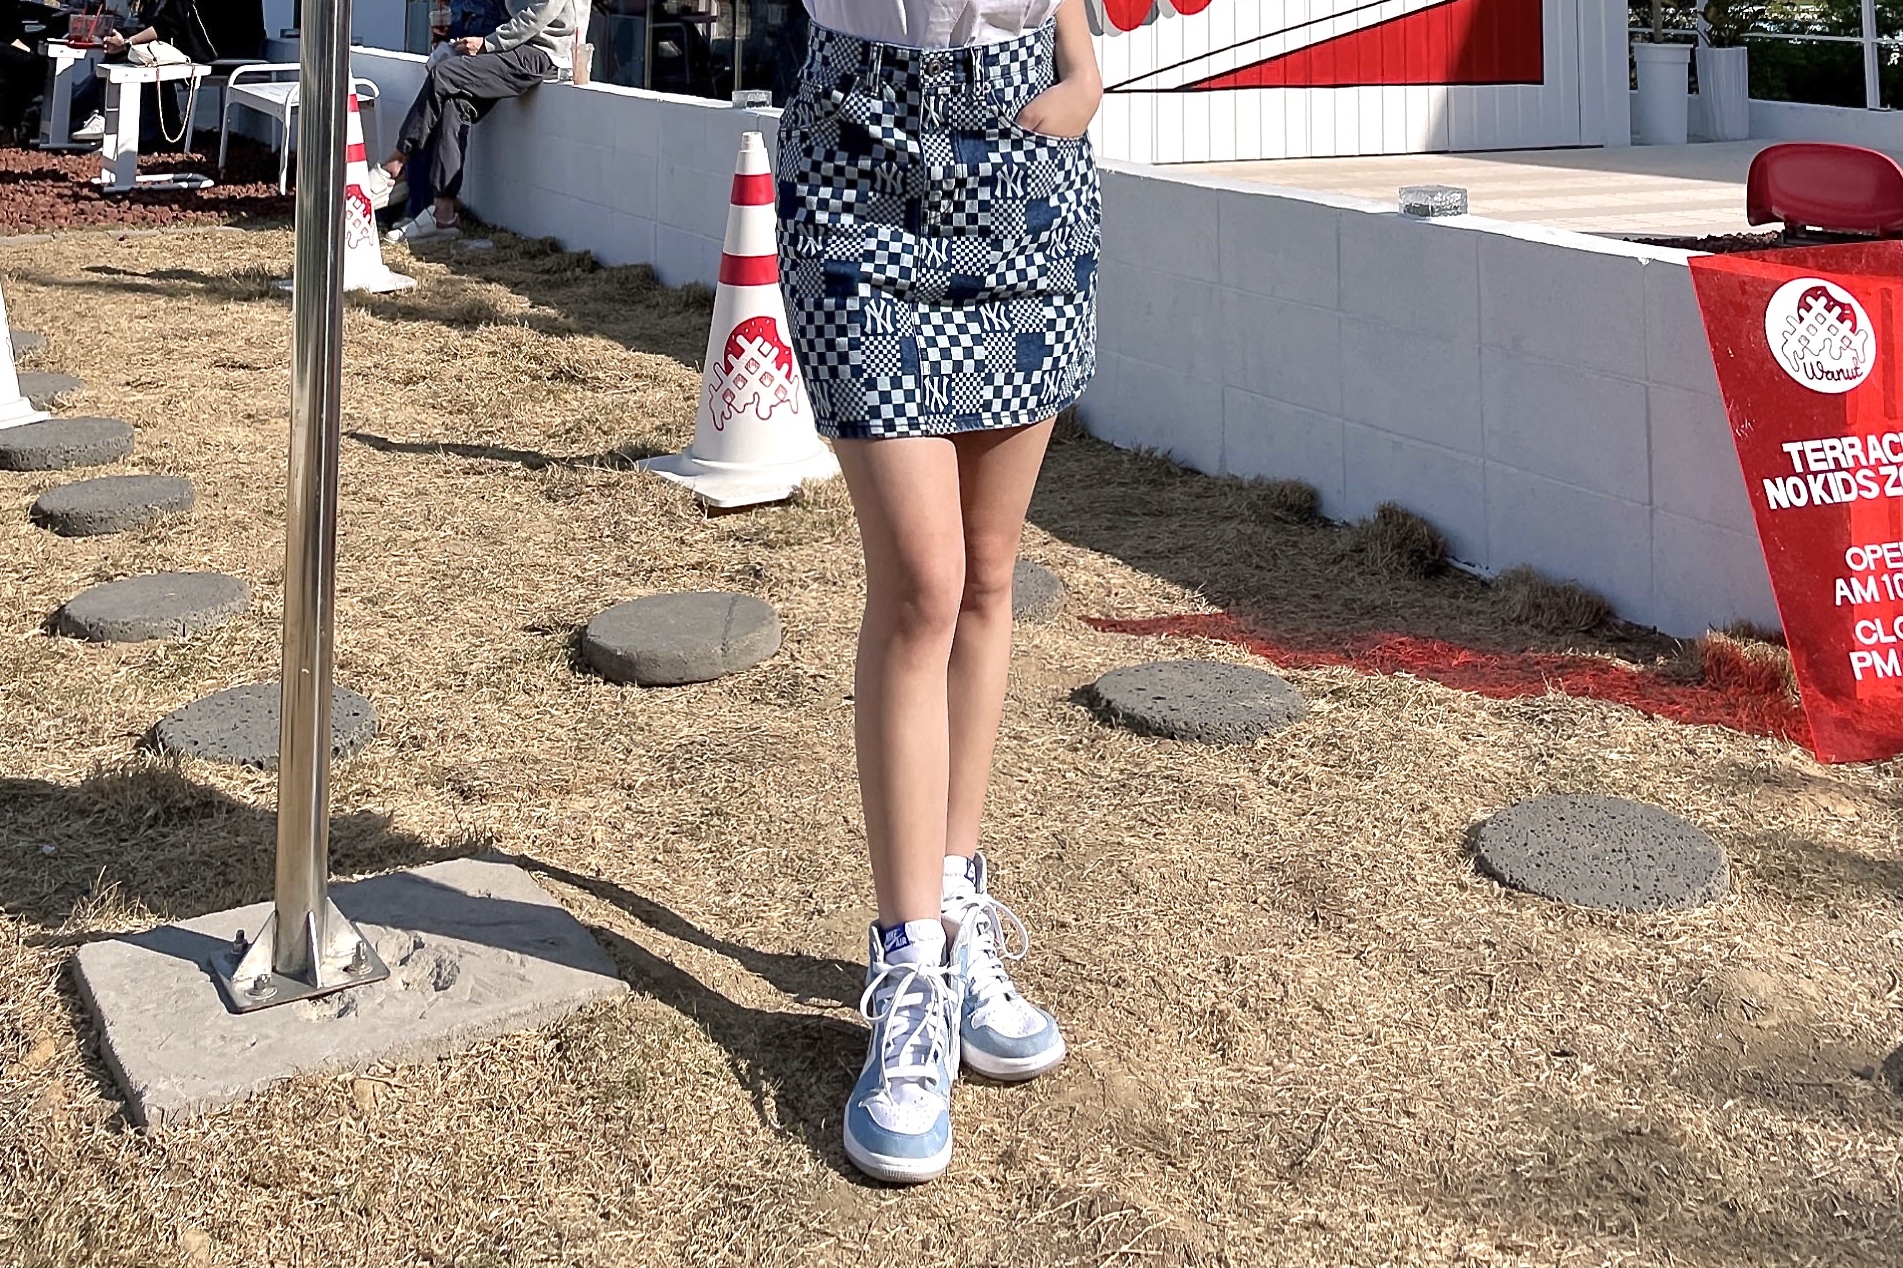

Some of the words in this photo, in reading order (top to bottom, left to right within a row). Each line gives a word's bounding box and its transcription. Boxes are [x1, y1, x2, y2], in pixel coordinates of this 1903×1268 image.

[994, 163, 1025, 198] NY
[864, 298, 895, 334] NY
[979, 301, 1012, 331] NY
[1803, 356, 1863, 382] Wanut
[923, 375, 950, 413] NY
[1782, 432, 1903, 473] TERRAC
[1806, 468, 1880, 506] KIDS
[1845, 542, 1903, 572] OPE
[1835, 575, 1881, 606] AM
[1849, 648, 1903, 681] PM
